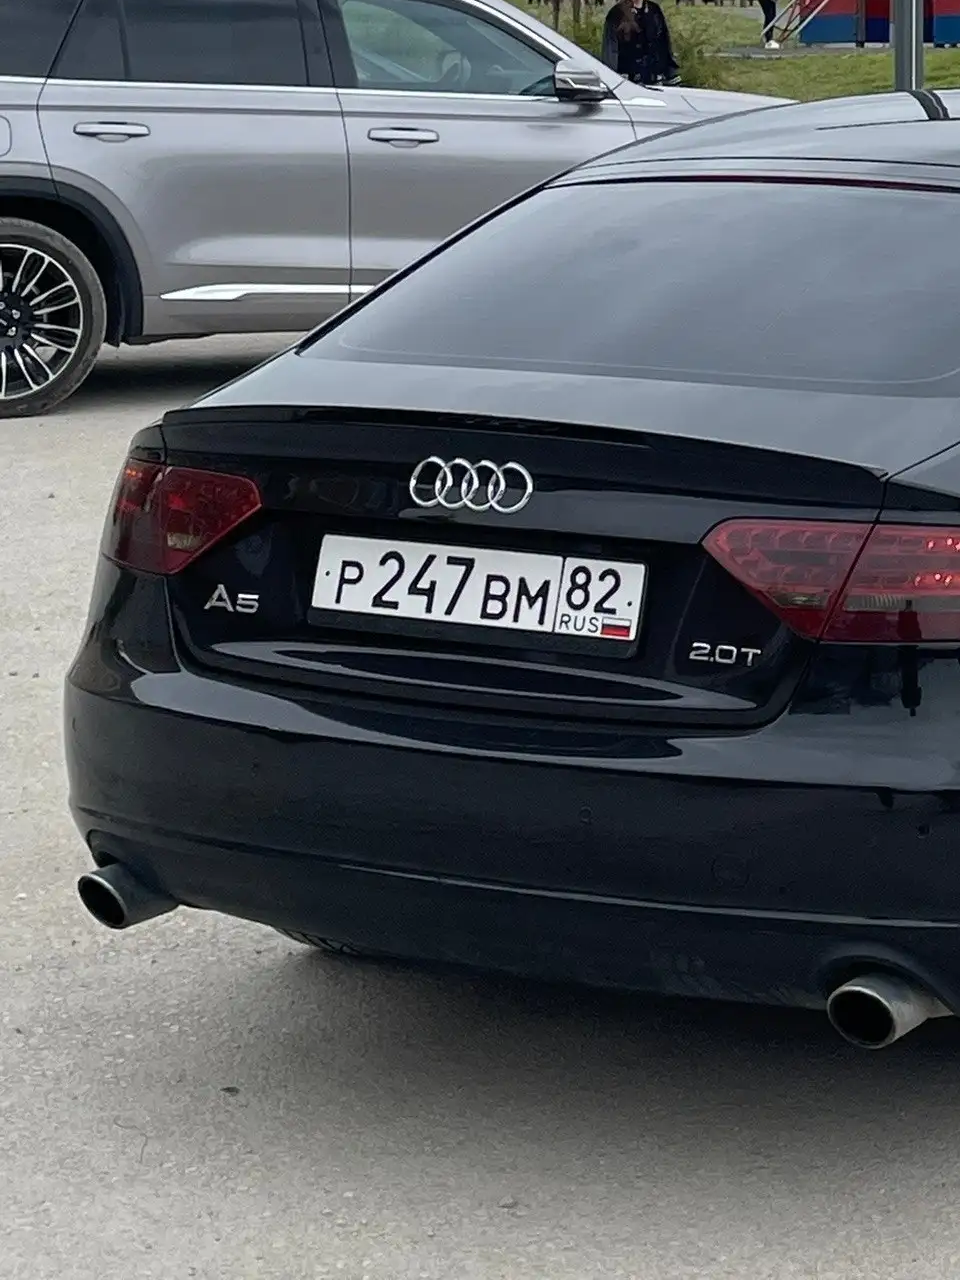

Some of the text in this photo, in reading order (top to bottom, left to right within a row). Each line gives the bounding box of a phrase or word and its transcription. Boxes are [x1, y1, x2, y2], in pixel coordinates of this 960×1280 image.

[203, 584, 260, 613] A5
[565, 565, 621, 615] 82
[559, 613, 599, 633] RUS
[688, 642, 762, 666] 2.0T
